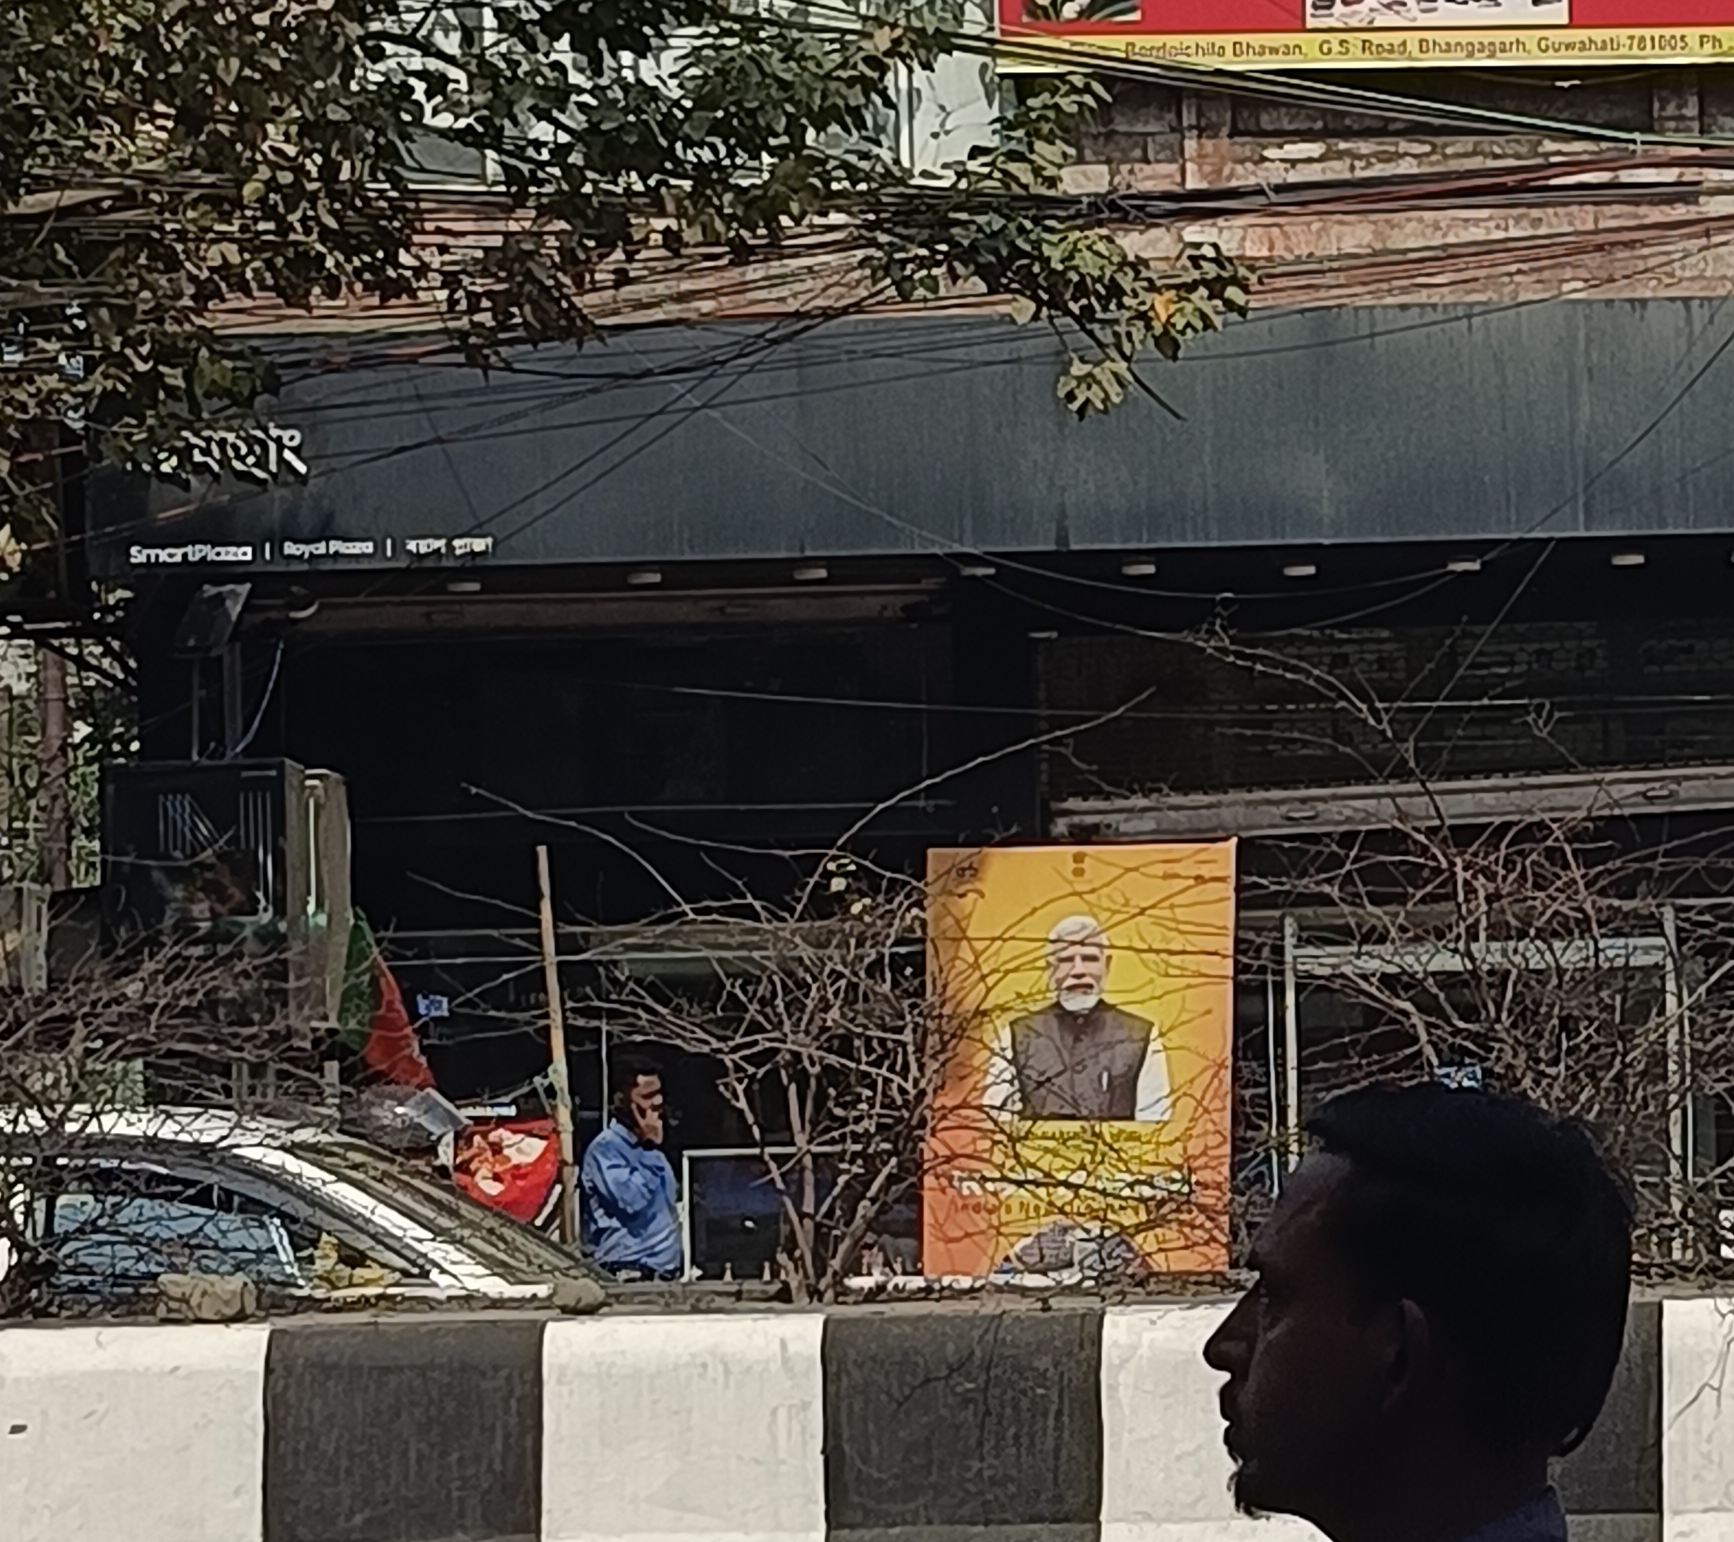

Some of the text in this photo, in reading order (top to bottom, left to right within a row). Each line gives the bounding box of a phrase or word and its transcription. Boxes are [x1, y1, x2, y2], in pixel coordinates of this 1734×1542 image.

[129, 540, 374, 564] SmartPlaza Royal Plaza
